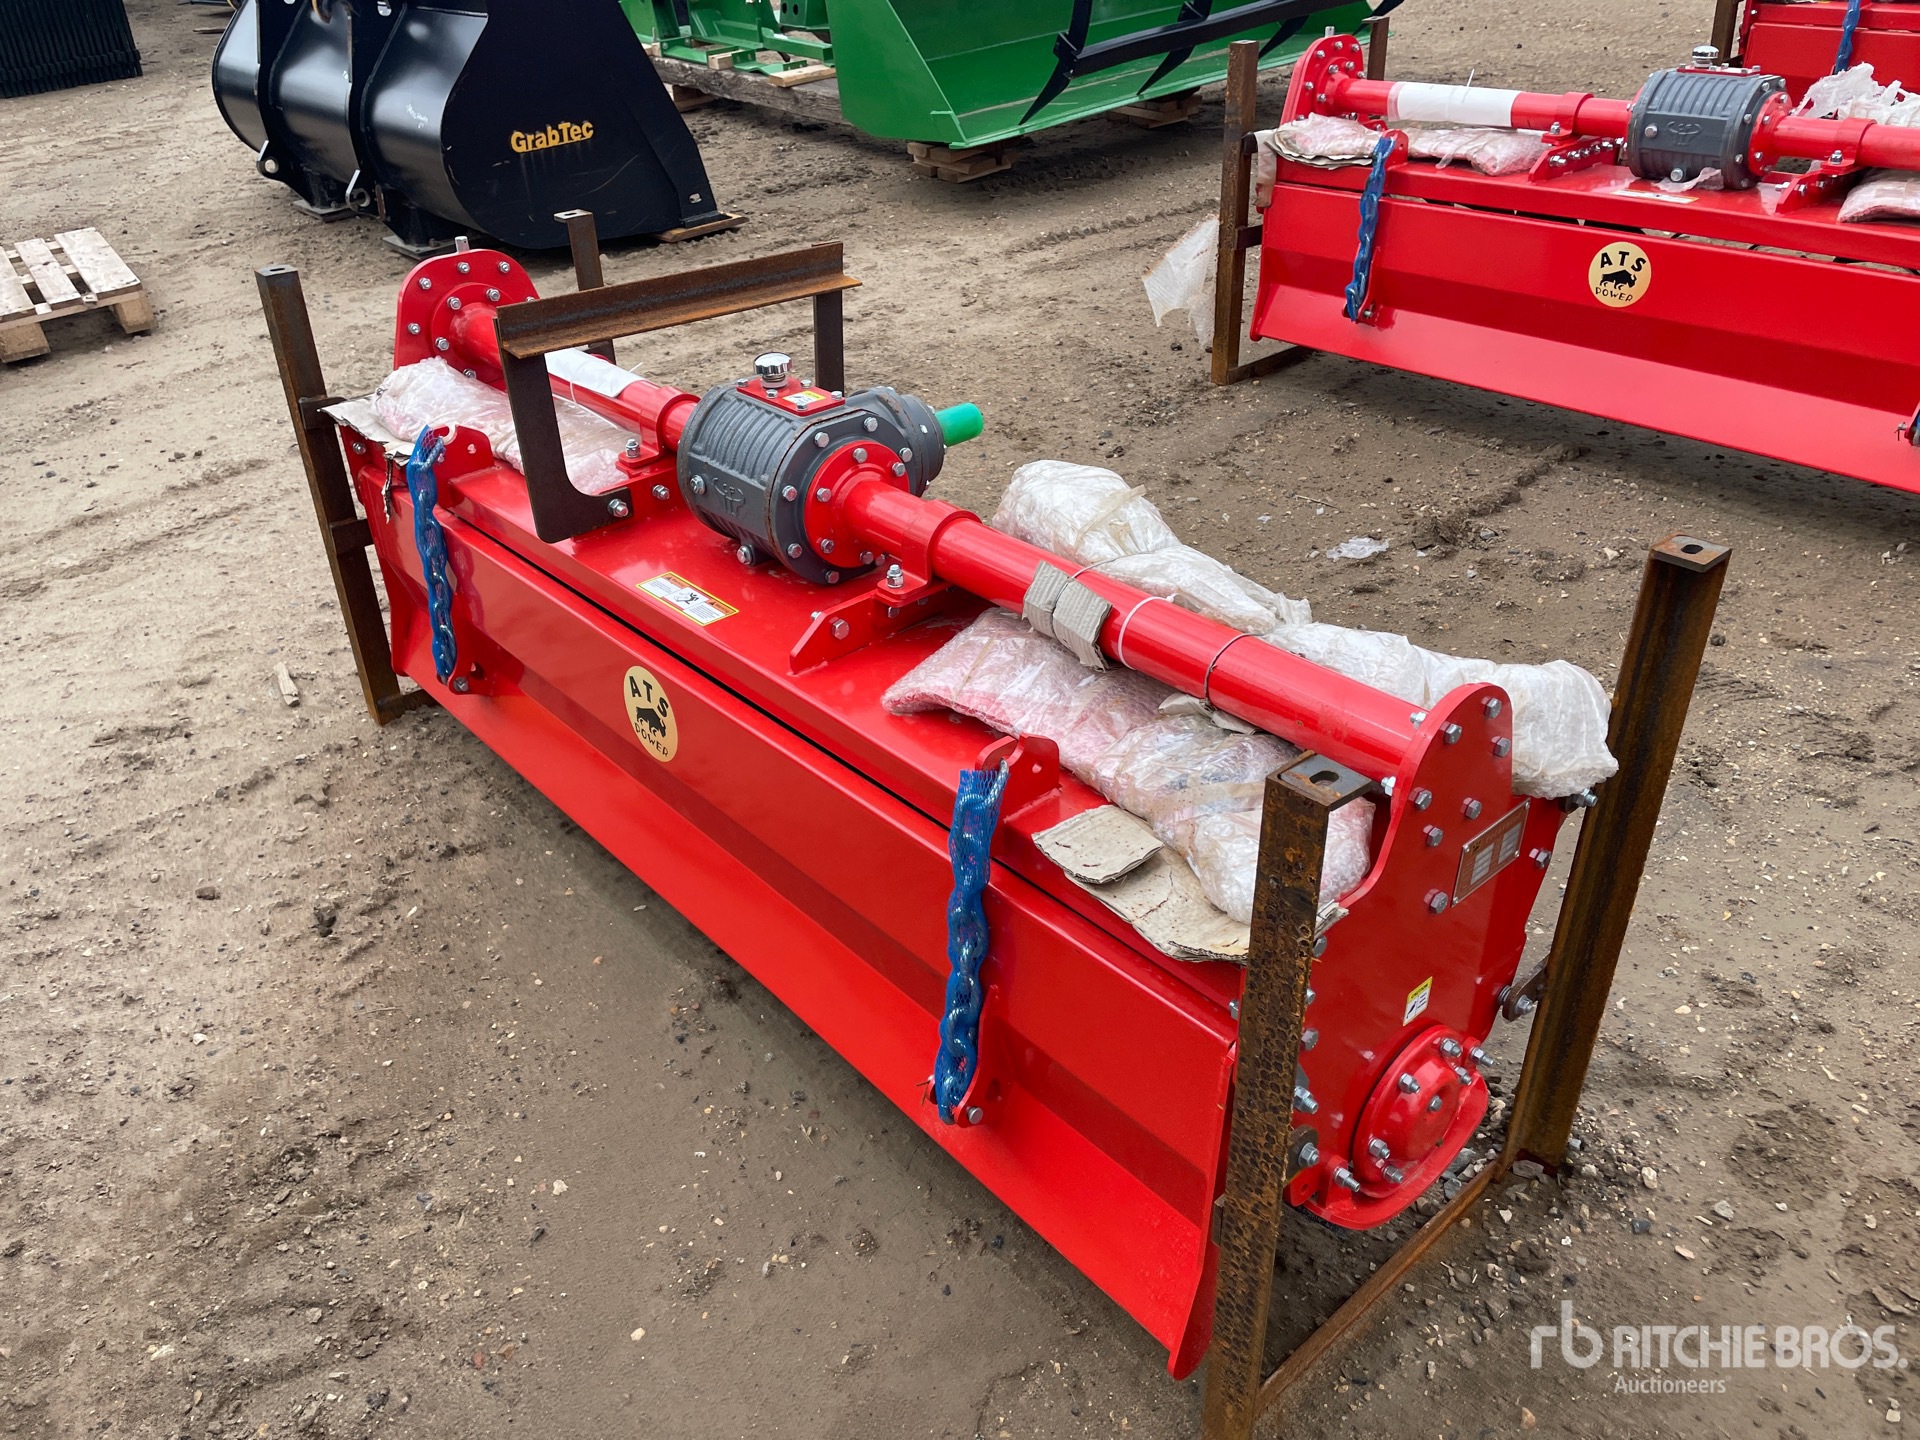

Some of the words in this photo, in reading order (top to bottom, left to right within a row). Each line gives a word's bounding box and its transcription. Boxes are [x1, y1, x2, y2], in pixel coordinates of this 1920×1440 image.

[511, 121, 594, 153] GrabTec
[1600, 250, 1647, 272] ATS
[1595, 286, 1633, 302] POWER
[629, 675, 669, 718] ATS
[634, 722, 669, 757] POWER
